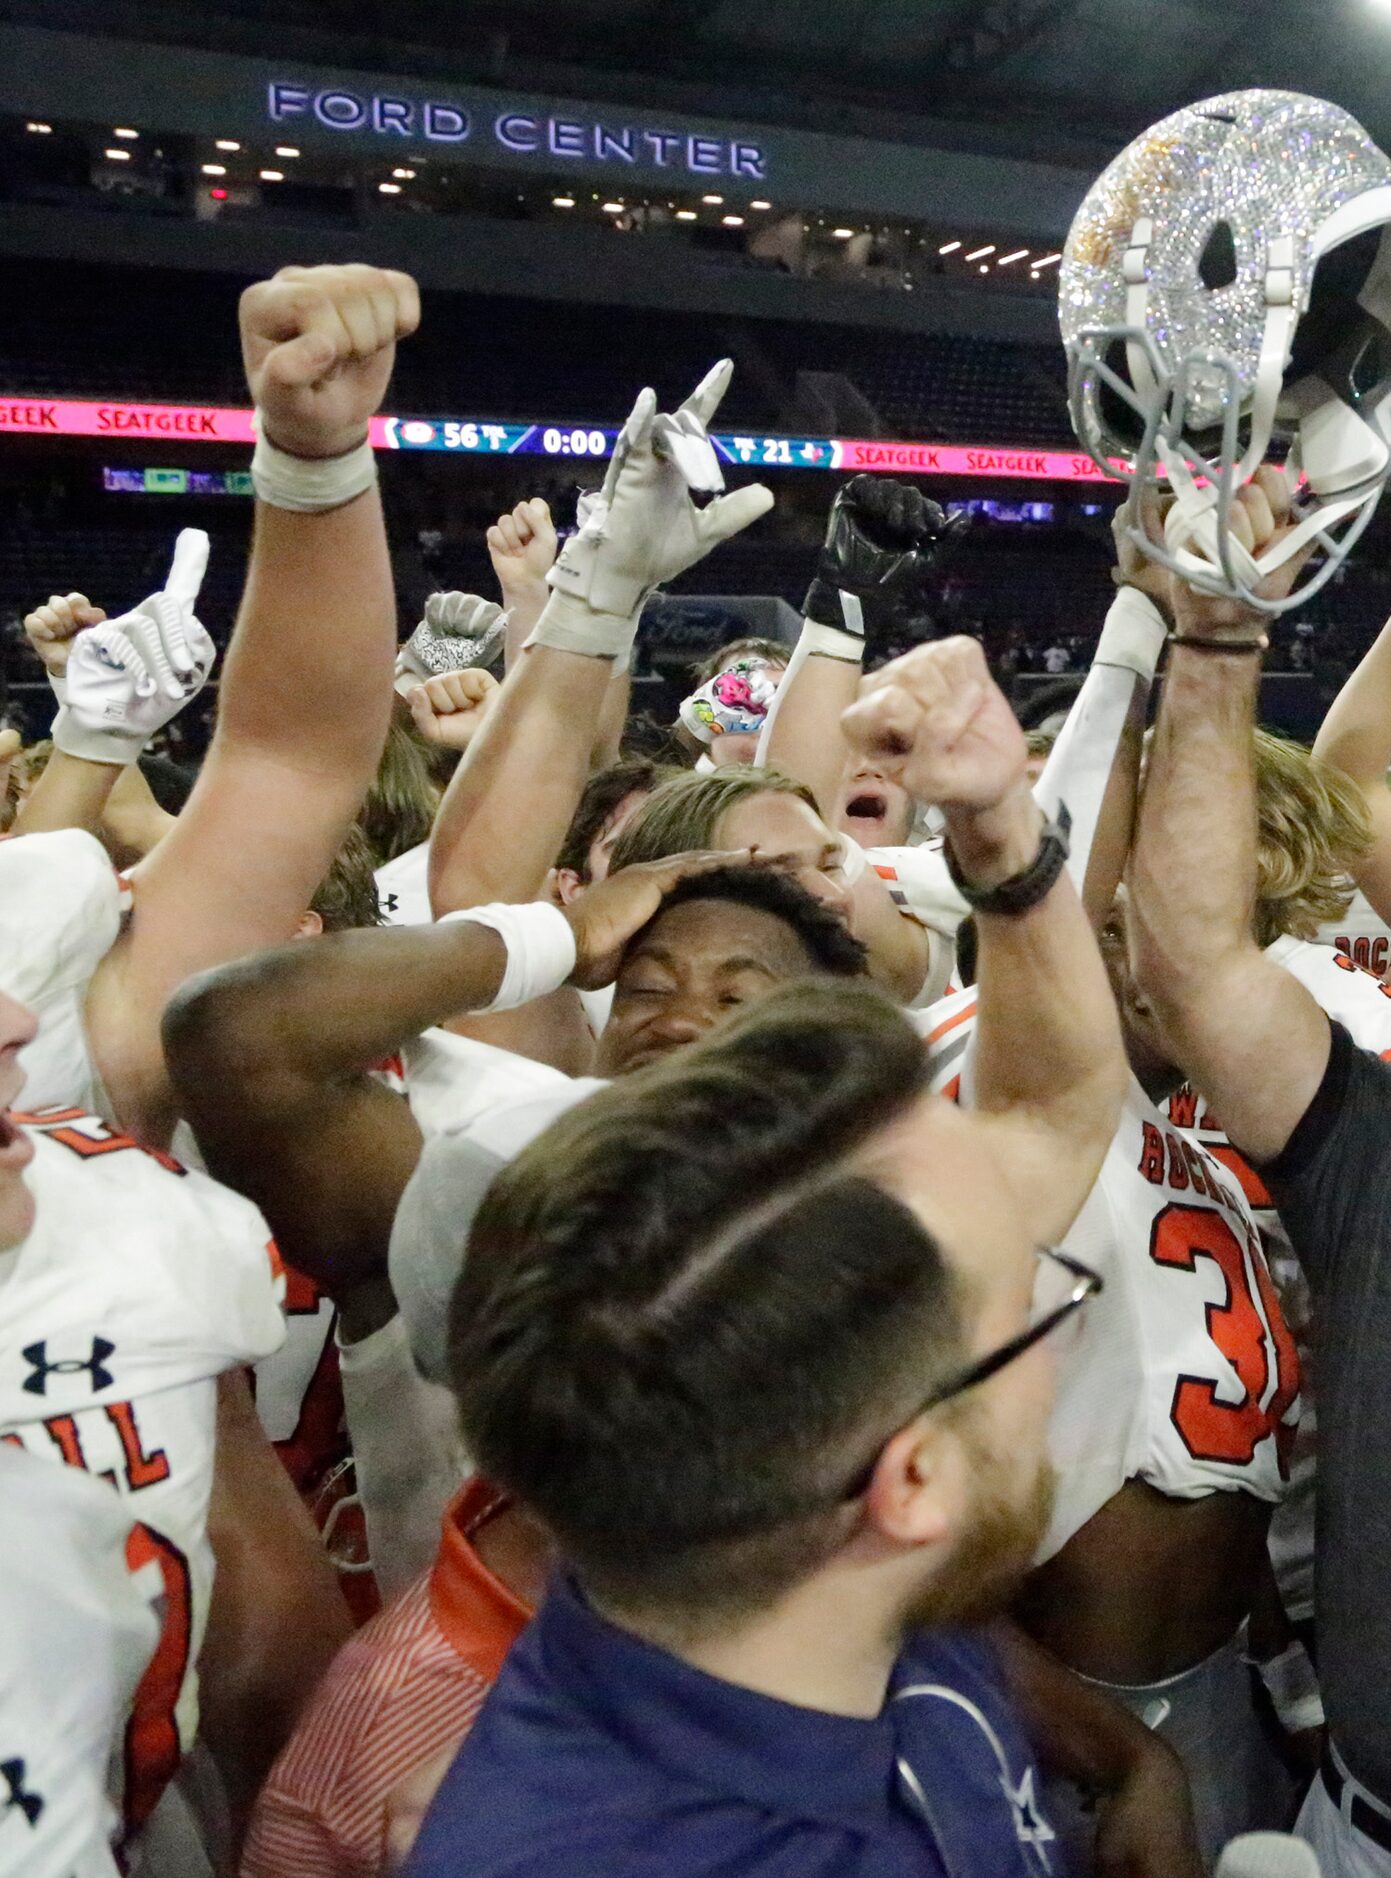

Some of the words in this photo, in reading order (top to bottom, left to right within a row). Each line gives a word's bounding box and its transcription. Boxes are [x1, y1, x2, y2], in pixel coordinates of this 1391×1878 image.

[267, 82, 471, 143] FORD
[495, 112, 767, 180] CENTER
[96, 409, 218, 435] SEATGEEK
[444, 423, 479, 448] 56
[543, 428, 606, 455] 0:00
[762, 439, 793, 463] 21
[855, 446, 941, 468] SEATGEEK
[966, 452, 1048, 474] SEATGEEK
[0, 1400, 171, 1493] LL
